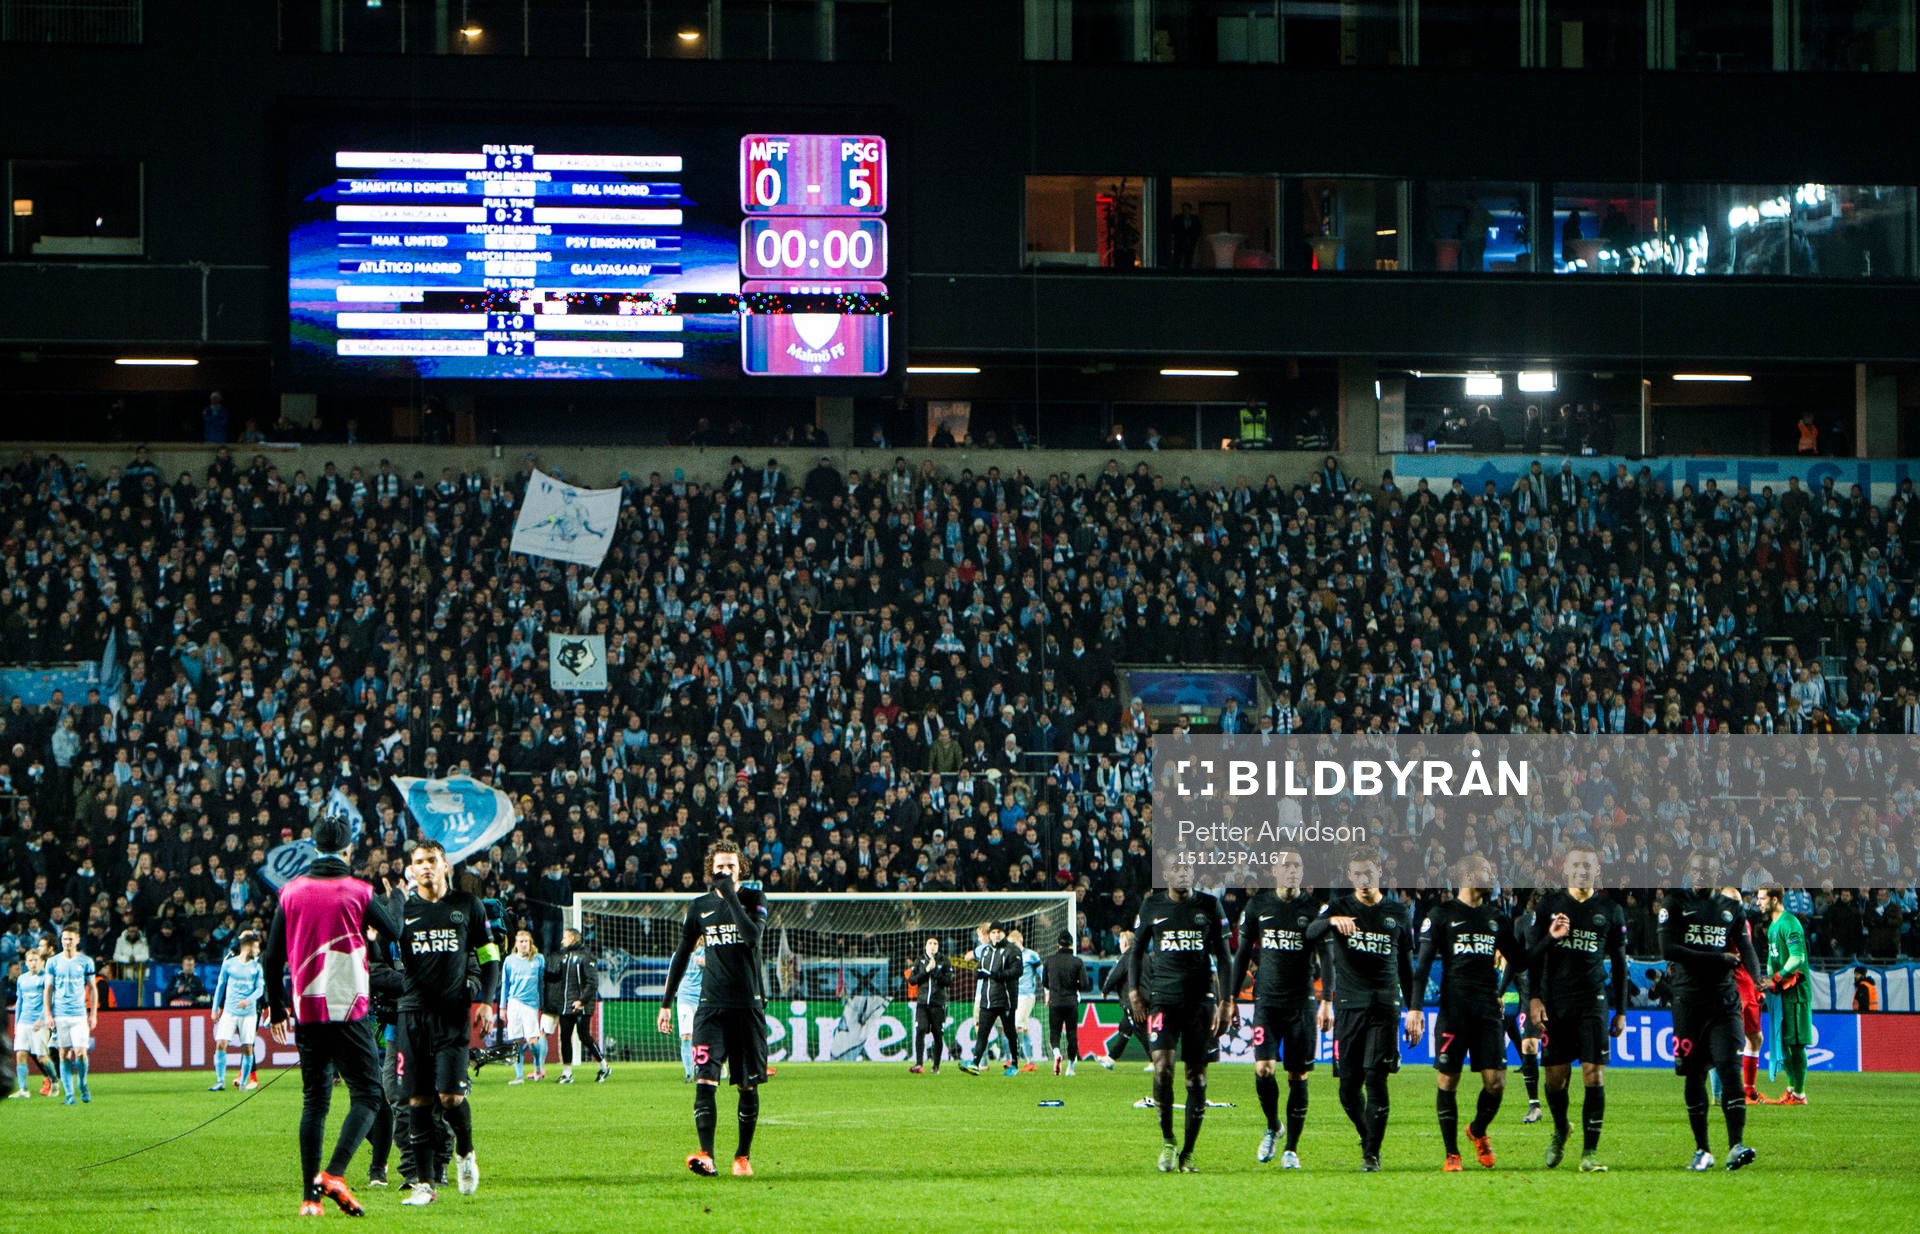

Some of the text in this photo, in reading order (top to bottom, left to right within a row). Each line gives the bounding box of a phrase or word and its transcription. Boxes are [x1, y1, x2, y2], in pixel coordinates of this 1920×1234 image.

[482, 144, 535, 155] FULL TIME
[749, 142, 790, 161] MFF
[841, 142, 879, 162] PSG
[494, 156, 522, 169] 0-5
[466, 171, 552, 182] MATCH RUNNING
[350, 181, 467, 194] SHAKHTAR DONETSK
[572, 184, 650, 196] REAL MADRID
[756, 168, 781, 207] 0
[849, 169, 871, 207] 5
[483, 198, 535, 209] FULL TIME
[494, 209, 522, 222] 0-2
[466, 225, 552, 235] MATCH RUNNING
[404, 236, 448, 247] UNITED
[566, 237, 656, 249] PSV EINDHOVEN
[756, 229, 873, 269] 00:00
[466, 251, 552, 262] MATCH RUNNING
[358, 259, 461, 274] ATLÉTICO MADRID
[571, 263, 652, 276] GALATASARAY
[483, 278, 535, 288] FULL TIME
[496, 316, 523, 328] 1-0
[484, 331, 535, 342] FULL TIME
[496, 342, 523, 355] 4-2
[413, 929, 457, 942] JE SUIS
[705, 926, 718, 935] JE
[1162, 930, 1203, 940] JE SUIS
[1263, 929, 1302, 940] JE SUIS
[1573, 929, 1598, 941] SUIS
[1688, 924, 1727, 935] JE SUIS
[1262, 938, 1303, 951] PARIS
[1365, 933, 1391, 944] SUIS
[1456, 934, 1496, 944] JE SUIS
[1684, 933, 1727, 948] PARIS
[411, 939, 459, 955] PARIS
[1161, 939, 1204, 952] PARIS
[1348, 939, 1392, 955] PARIS
[1453, 942, 1496, 955] PARIS
[1441, 1033, 1454, 1053] 7
[1672, 1036, 1693, 1057] 29
